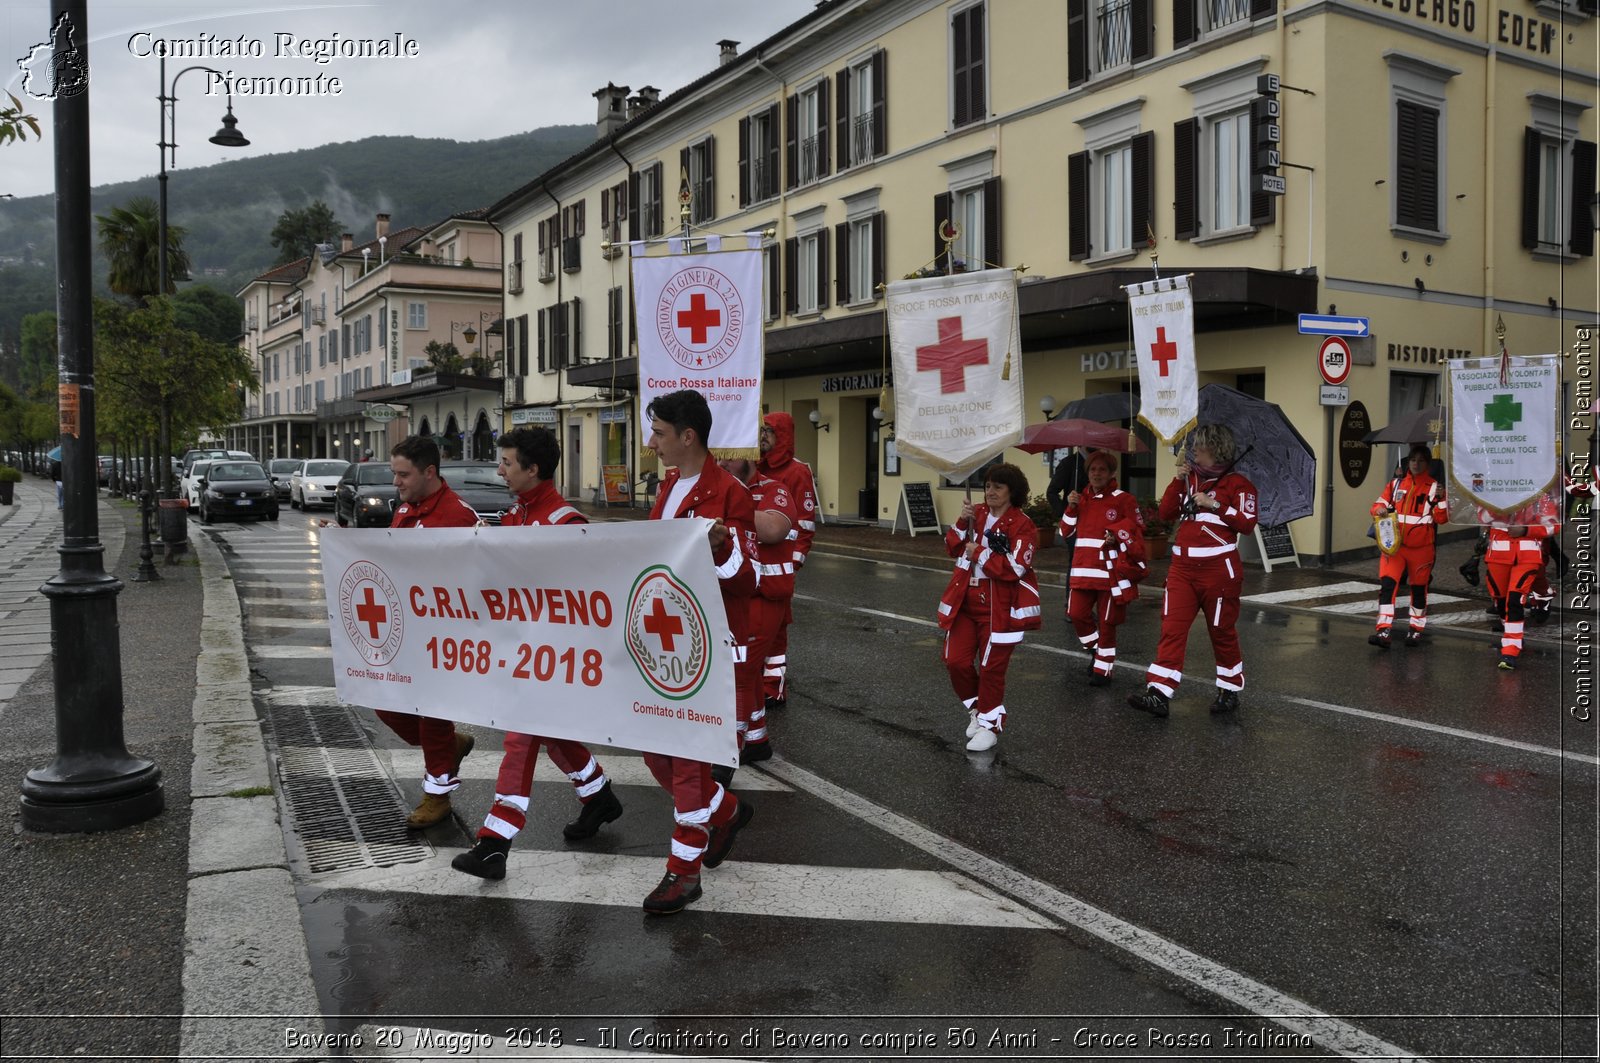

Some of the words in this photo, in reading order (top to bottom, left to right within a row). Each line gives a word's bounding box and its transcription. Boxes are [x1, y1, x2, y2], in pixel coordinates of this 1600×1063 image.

[1498, 9, 1552, 54] EDEN
[1268, 77, 1279, 165] EDEN
[1263, 177, 1285, 191] HOTEL
[677, 270, 721, 289] GINEVRA
[667, 284, 678, 298] DI
[722, 287, 735, 302] 22
[893, 302, 925, 314] CROCE
[929, 297, 961, 309] ROSSA
[964, 291, 1010, 304] ITALIANA
[660, 297, 693, 365] CONVENZIONE
[725, 304, 741, 347] AGOSTO
[707, 345, 728, 365] 1864
[1081, 350, 1138, 372] HOTE
[647, 377, 677, 389] Croce
[680, 377, 714, 389] Rossa
[717, 376, 757, 388] Italiana
[1464, 382, 1497, 391] PUBBLICA
[709, 392, 742, 401] Baveno
[918, 401, 993, 417] DELEGAZIONE
[950, 416, 959, 426] DI
[906, 427, 977, 441] GRAVELLONA
[982, 423, 1013, 436] TOCE
[1470, 447, 1516, 455] GRAVELLONA
[1518, 446, 1538, 454] TOCE
[1485, 478, 1535, 486] PROVINCIA
[345, 577, 354, 589] DI
[352, 565, 385, 588] GINEVRA
[385, 583, 395, 599] 22
[409, 585, 479, 620] C.R.I.
[480, 587, 613, 628] BAVENO
[341, 587, 373, 659] CONVENZIONE
[391, 601, 402, 648] AGOSTO
[426, 636, 492, 675] 1968
[512, 643, 603, 687] 2018
[659, 655, 683, 684] 50
[346, 667, 366, 678] Croce
[366, 669, 384, 681] Rossa
[386, 672, 412, 683] Italiana
[633, 701, 674, 718] Comitato
[676, 707, 685, 720] di
[687, 709, 723, 726] Baveno
